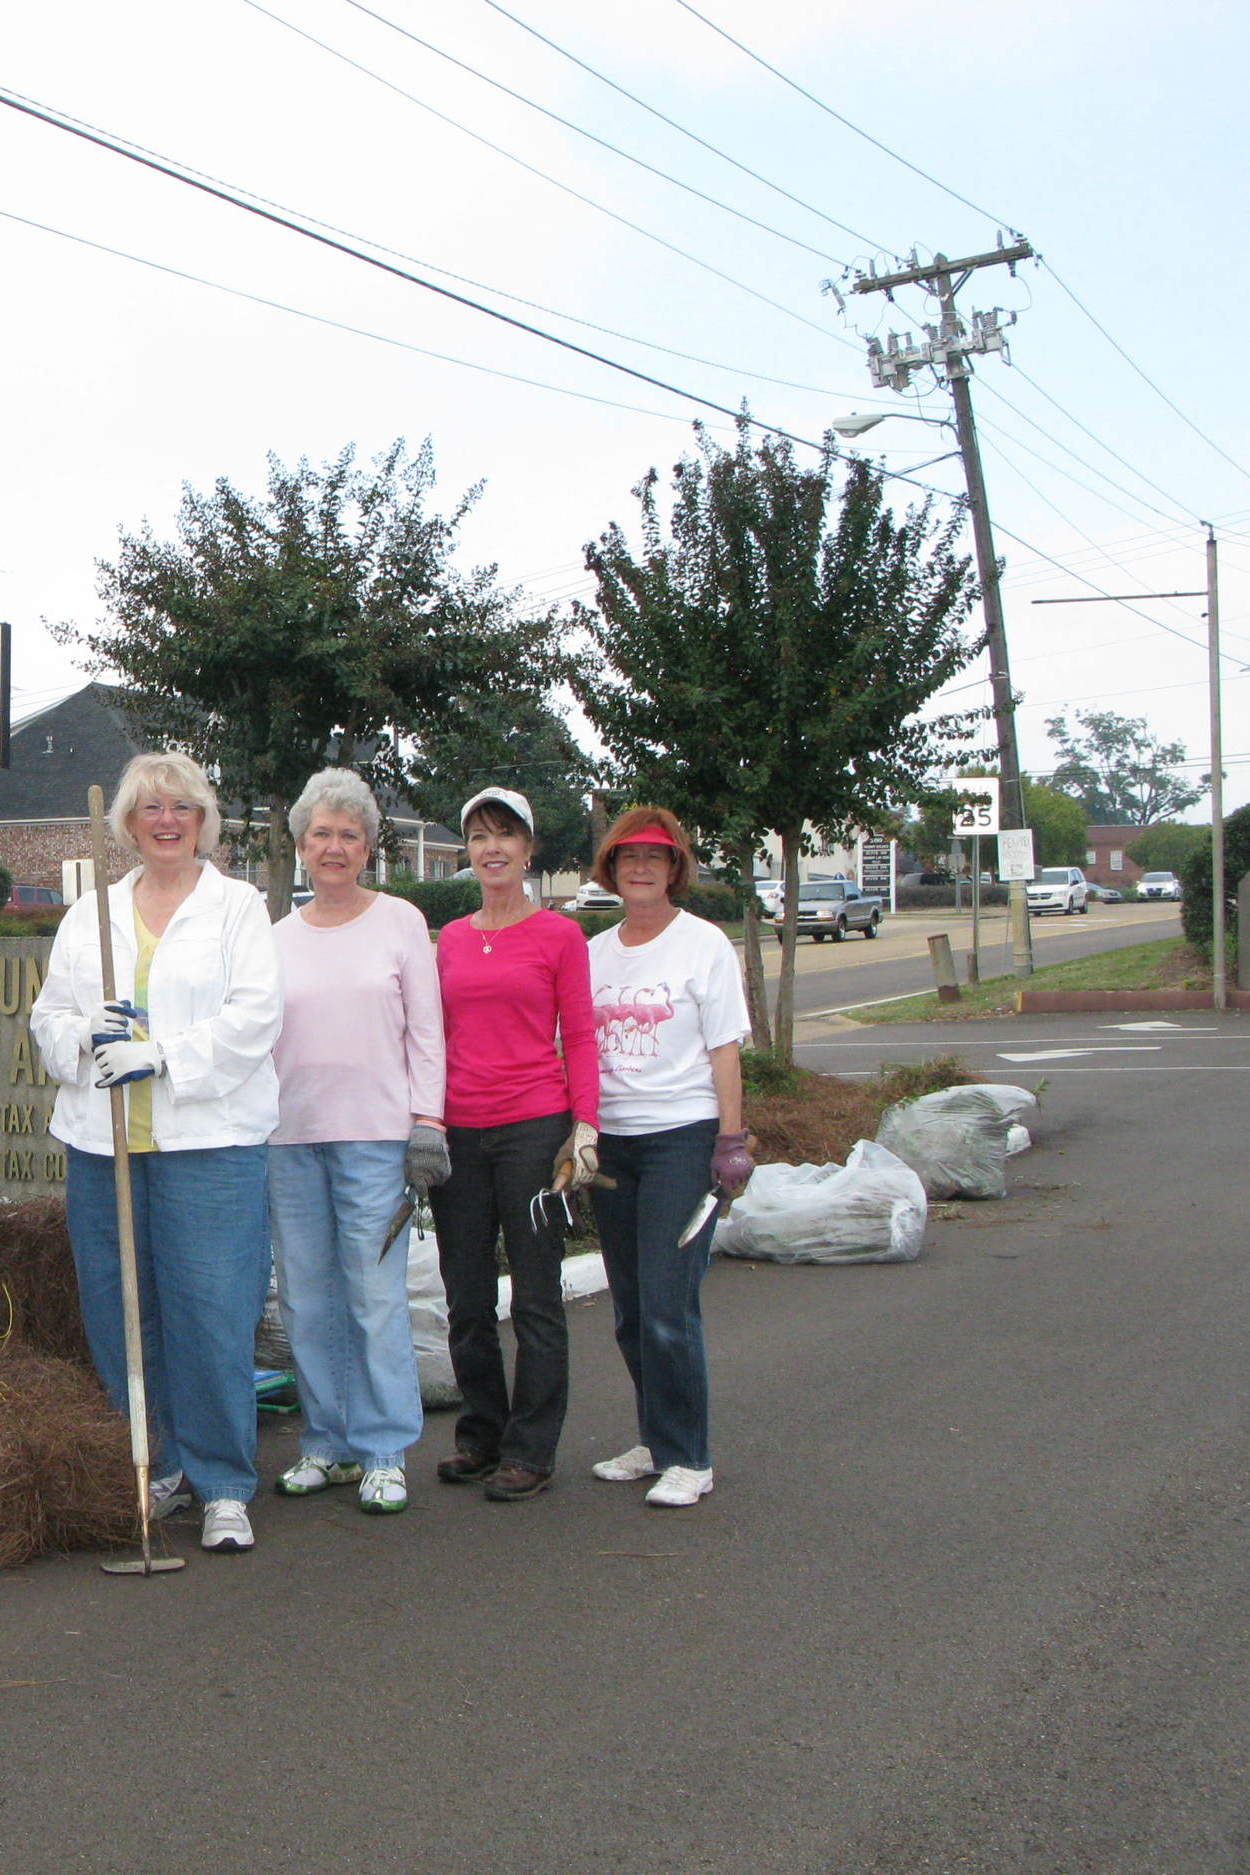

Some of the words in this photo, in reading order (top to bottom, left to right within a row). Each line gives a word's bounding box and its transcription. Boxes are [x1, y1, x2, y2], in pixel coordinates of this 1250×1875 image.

[959, 807, 992, 827] 25
[0, 1104, 34, 1134] TAX
[1, 1149, 34, 1180] TAX
